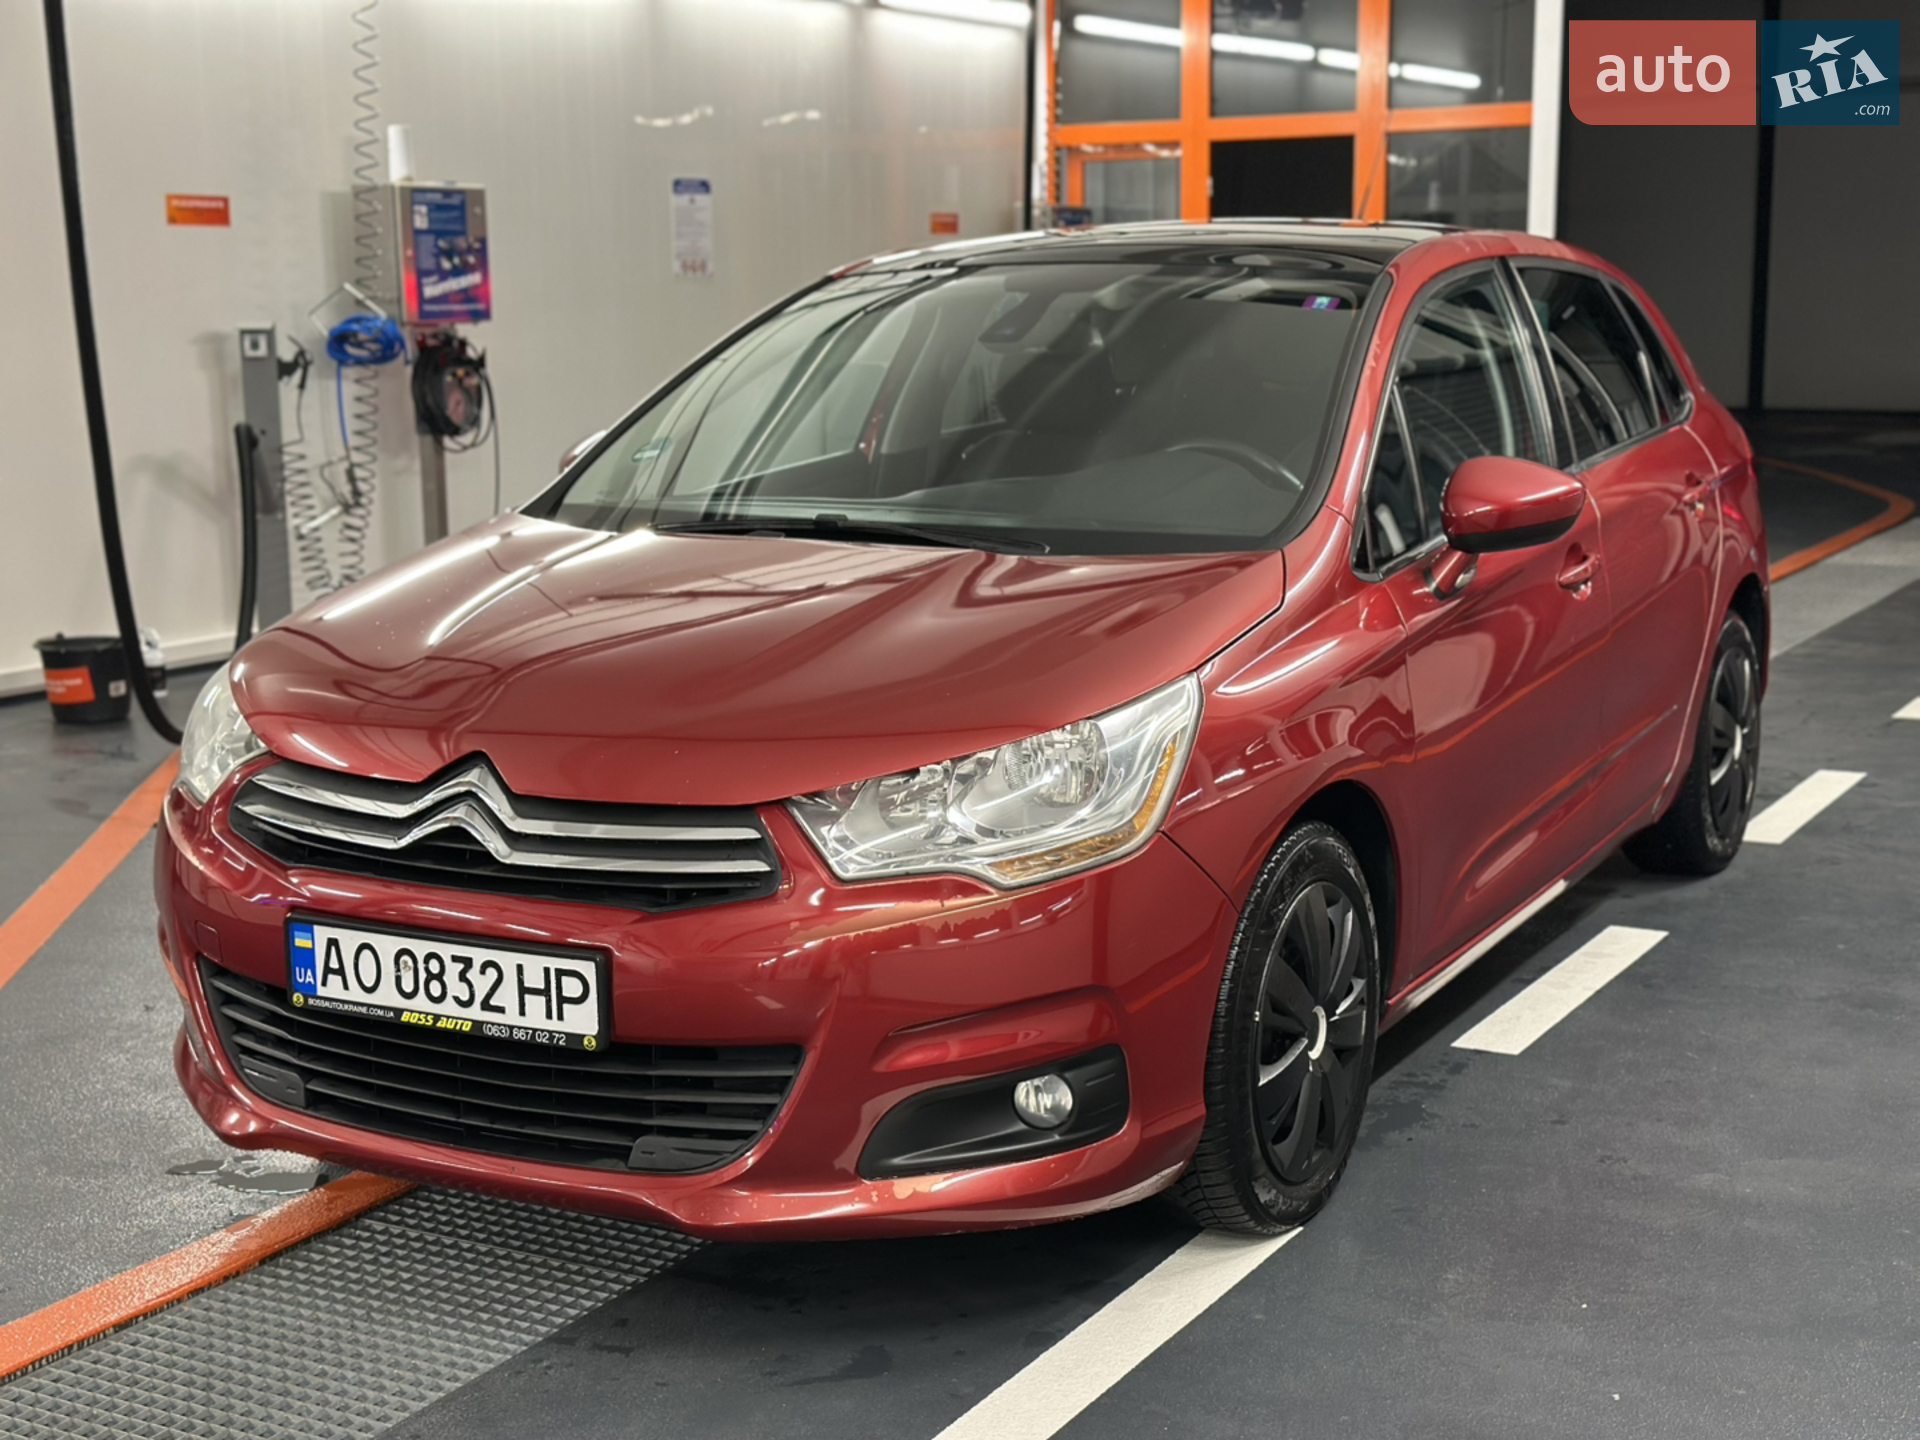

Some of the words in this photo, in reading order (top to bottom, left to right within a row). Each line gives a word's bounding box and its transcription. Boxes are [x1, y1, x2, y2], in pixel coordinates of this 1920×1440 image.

[295, 966, 315, 985] UA
[321, 937, 382, 994] AO
[394, 947, 506, 1014] 0832
[516, 963, 591, 1022] HP
[307, 997, 395, 1018] BOSSAUTOUKRAINE.COM.UA
[400, 1011, 435, 1026] BOSS
[436, 1016, 473, 1032] AUTO
[482, 1023, 510, 1038] (063)
[512, 1027, 533, 1041] 667
[535, 1031, 550, 1044] 02
[552, 1033, 566, 1046] 72
